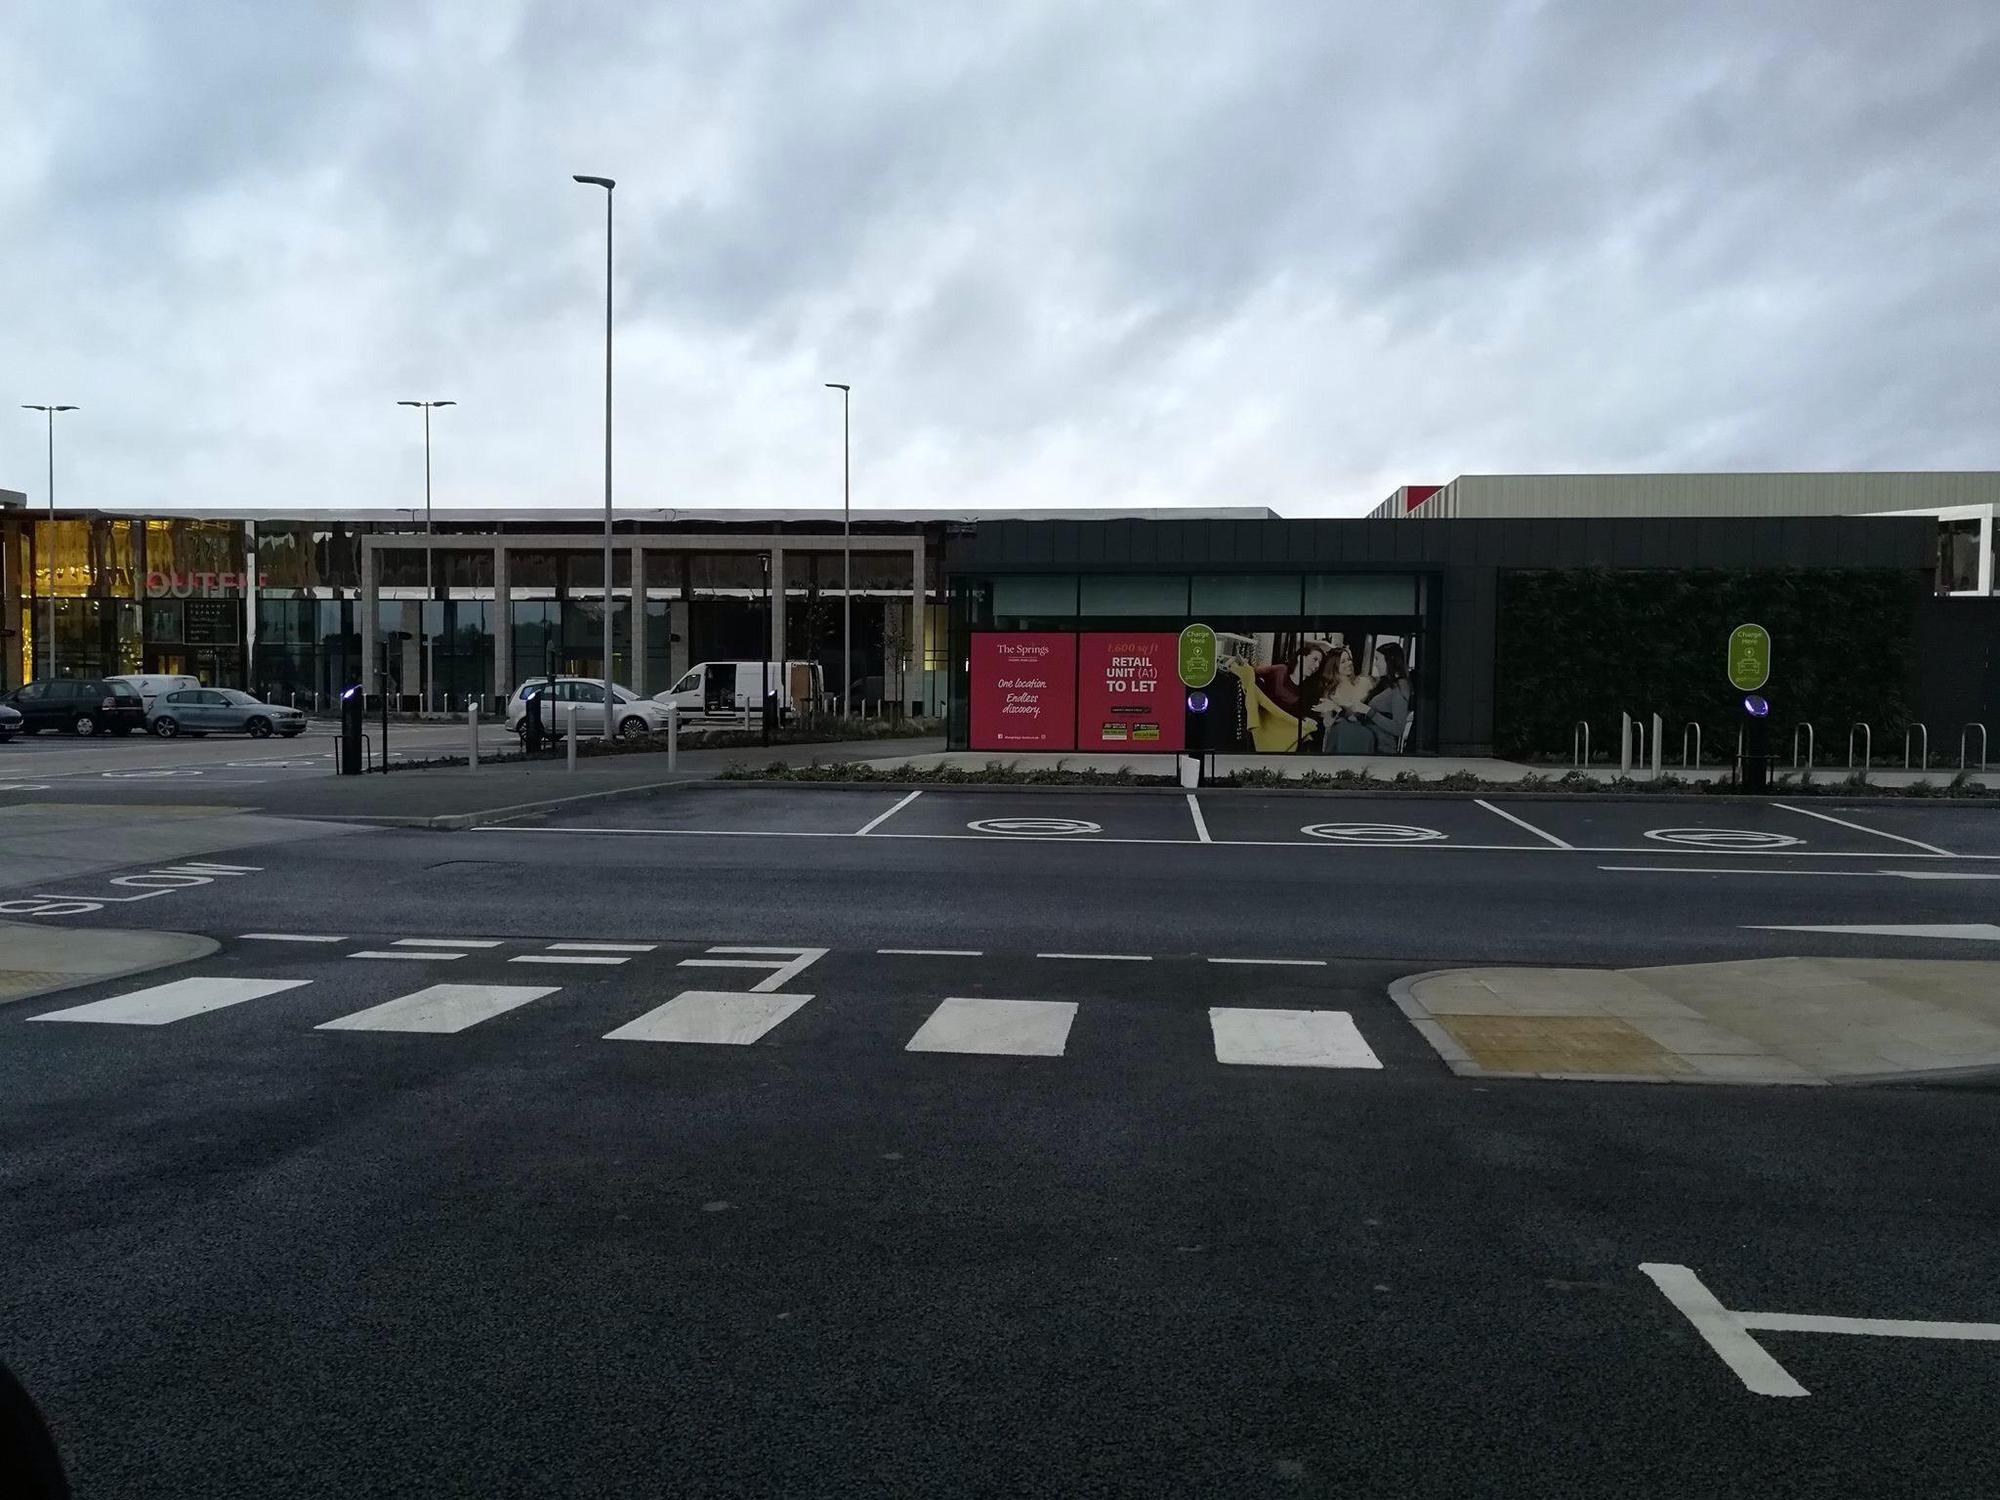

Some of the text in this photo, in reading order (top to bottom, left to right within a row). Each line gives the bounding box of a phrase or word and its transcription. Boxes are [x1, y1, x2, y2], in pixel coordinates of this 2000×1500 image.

[997, 644, 1049, 656] The Springs
[1112, 657, 1153, 667] RETAIL
[1106, 668, 1158, 679] UNIT (A1)
[997, 677, 1047, 688] One location.
[1106, 680, 1157, 692] TO LET
[1006, 692, 1039, 703] Endless
[1002, 703, 1041, 719] discovery.
[0, 862, 265, 916] SLOW
